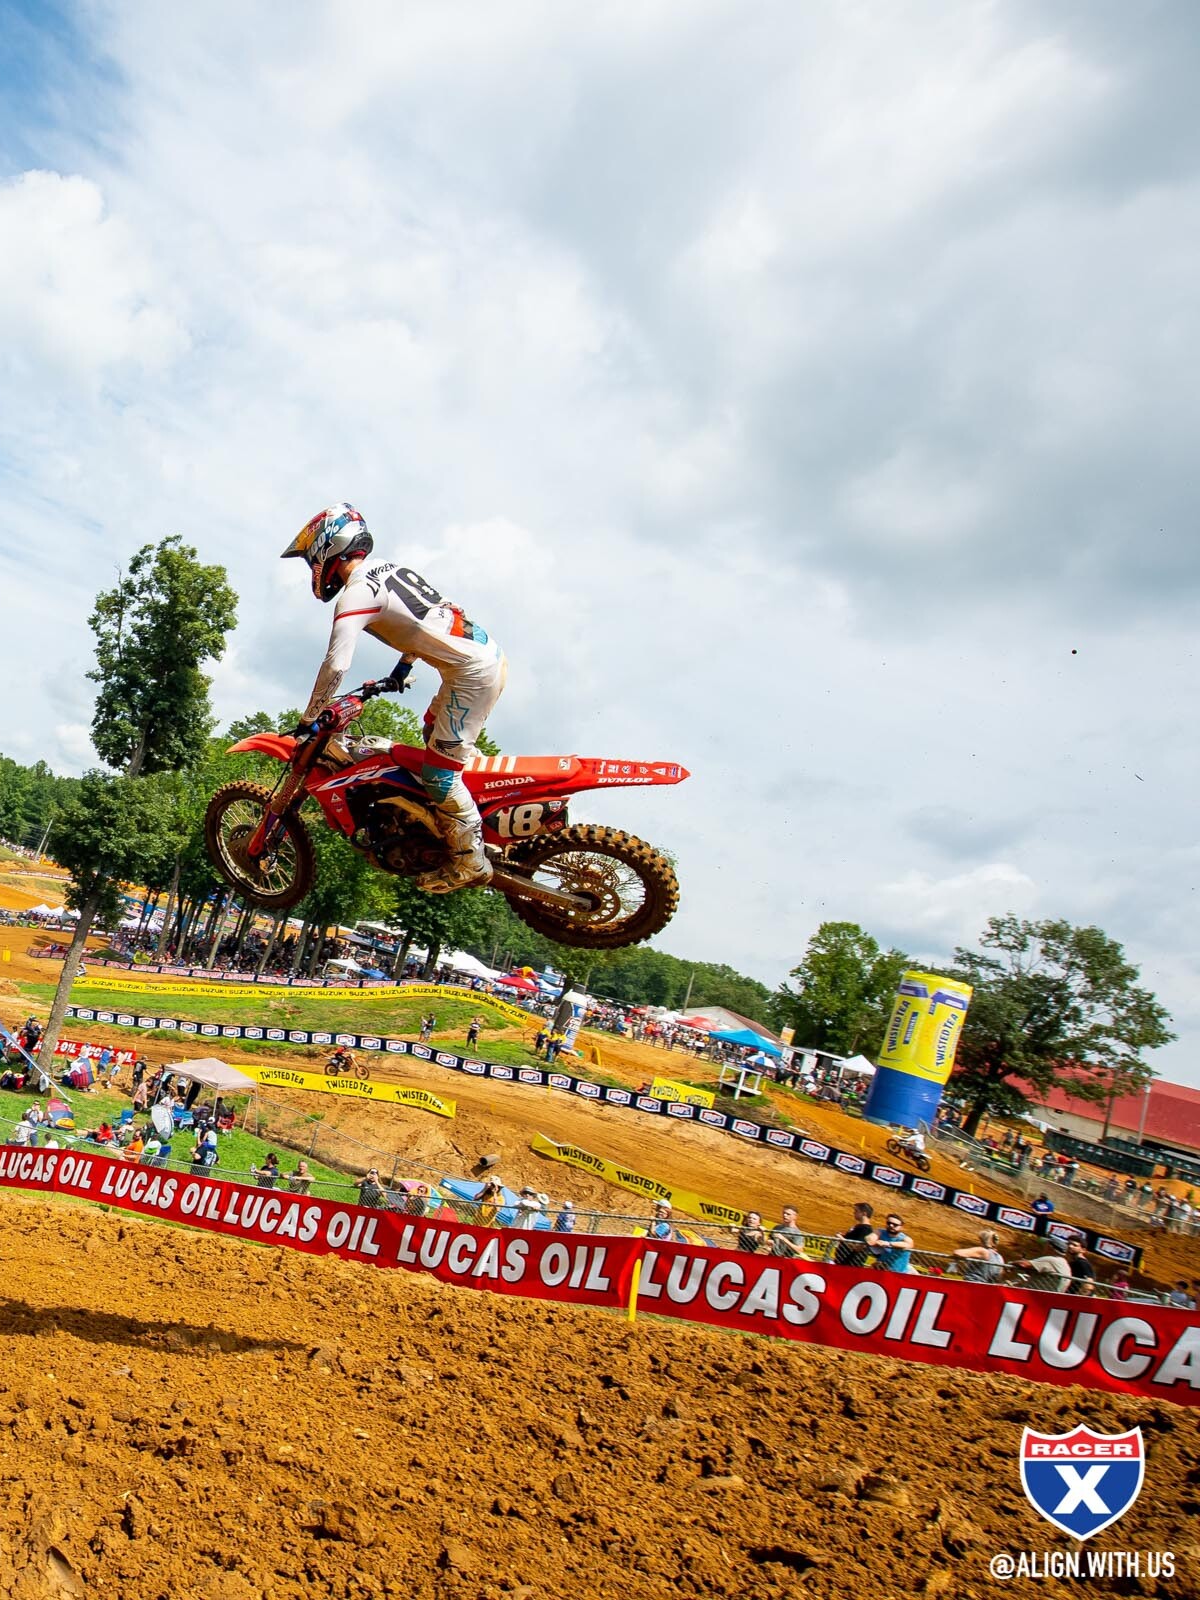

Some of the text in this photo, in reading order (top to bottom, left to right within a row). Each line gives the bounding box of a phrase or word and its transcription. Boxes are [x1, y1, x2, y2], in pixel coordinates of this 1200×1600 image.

[385, 568, 442, 620] 18
[484, 776, 535, 789] HONDA
[497, 803, 543, 838] 18
[897, 1000, 911, 1017] TEA
[60, 1041, 77, 1054] OIL
[935, 1027, 951, 1067] TWISTED
[944, 1013, 959, 1029] TEA
[260, 1071, 289, 1080] TWISTED
[290, 1072, 305, 1085] TEA
[326, 1080, 359, 1090] TWISTED
[359, 1082, 374, 1096] TEA
[395, 1090, 428, 1101] TWISTED
[556, 1146, 593, 1164] TWISTED
[615, 1170, 655, 1190] TWISTED
[655, 1182, 672, 1200] TEA
[699, 1202, 741, 1223] TWISTED
[58, 1155, 93, 1189] OIL
[100, 1165, 178, 1210] LUCAS
[179, 1181, 222, 1221] OIL
[223, 1191, 321, 1242] LUCAS
[325, 1210, 381, 1256] OIL
[397, 1225, 529, 1283] LUCAS
[538, 1241, 610, 1291] OIL
[638, 1250, 827, 1326] LUCAS
[840, 1280, 952, 1349] OIL
[988, 1301, 1200, 1389] LUCA
